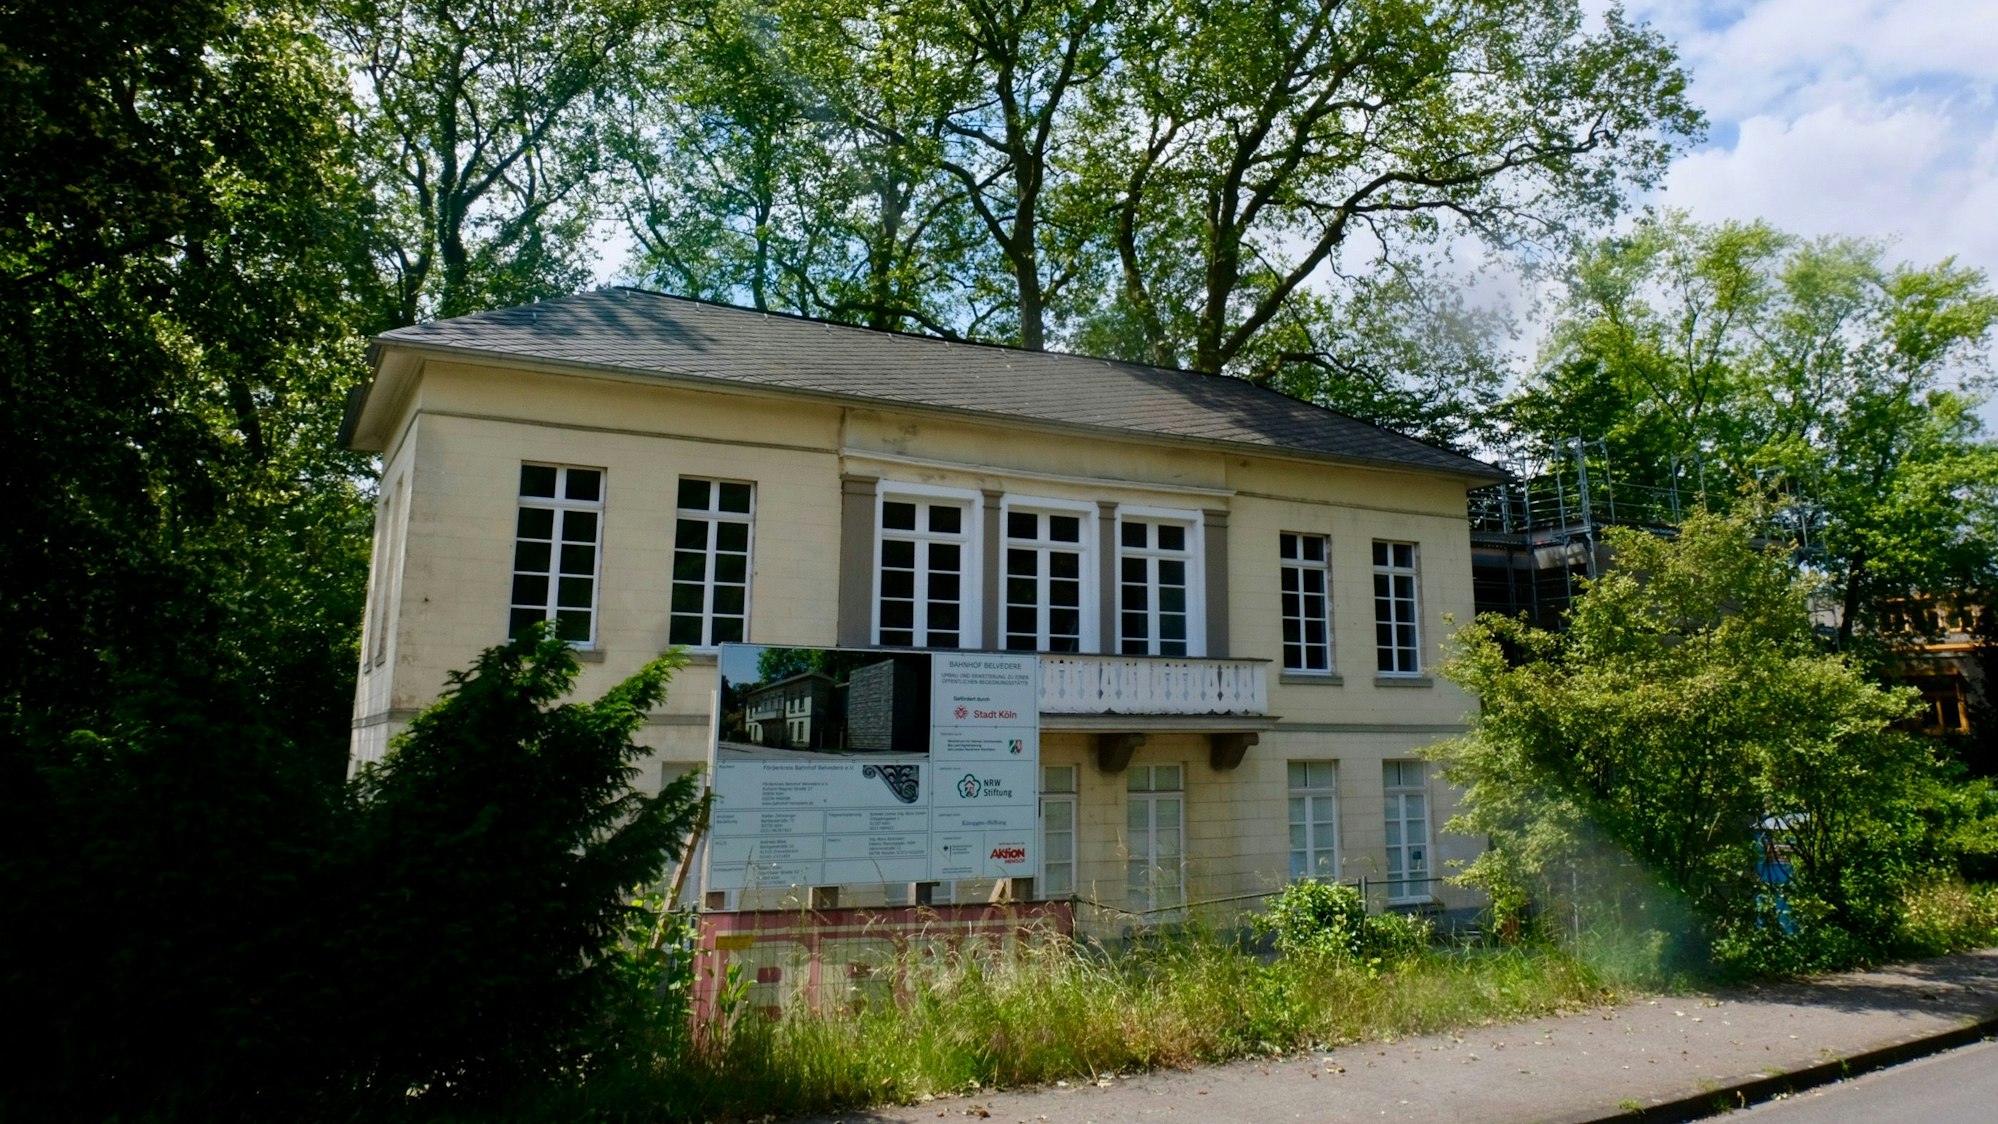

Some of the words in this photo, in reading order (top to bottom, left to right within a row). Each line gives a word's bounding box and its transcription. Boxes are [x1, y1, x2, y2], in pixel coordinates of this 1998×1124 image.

[984, 662, 1022, 670] BELVEDERE
[973, 709, 997, 719] Stadt
[998, 710, 1017, 719] Köln
[983, 779, 1001, 787] NRW
[983, 788, 1012, 798] Stiftung
